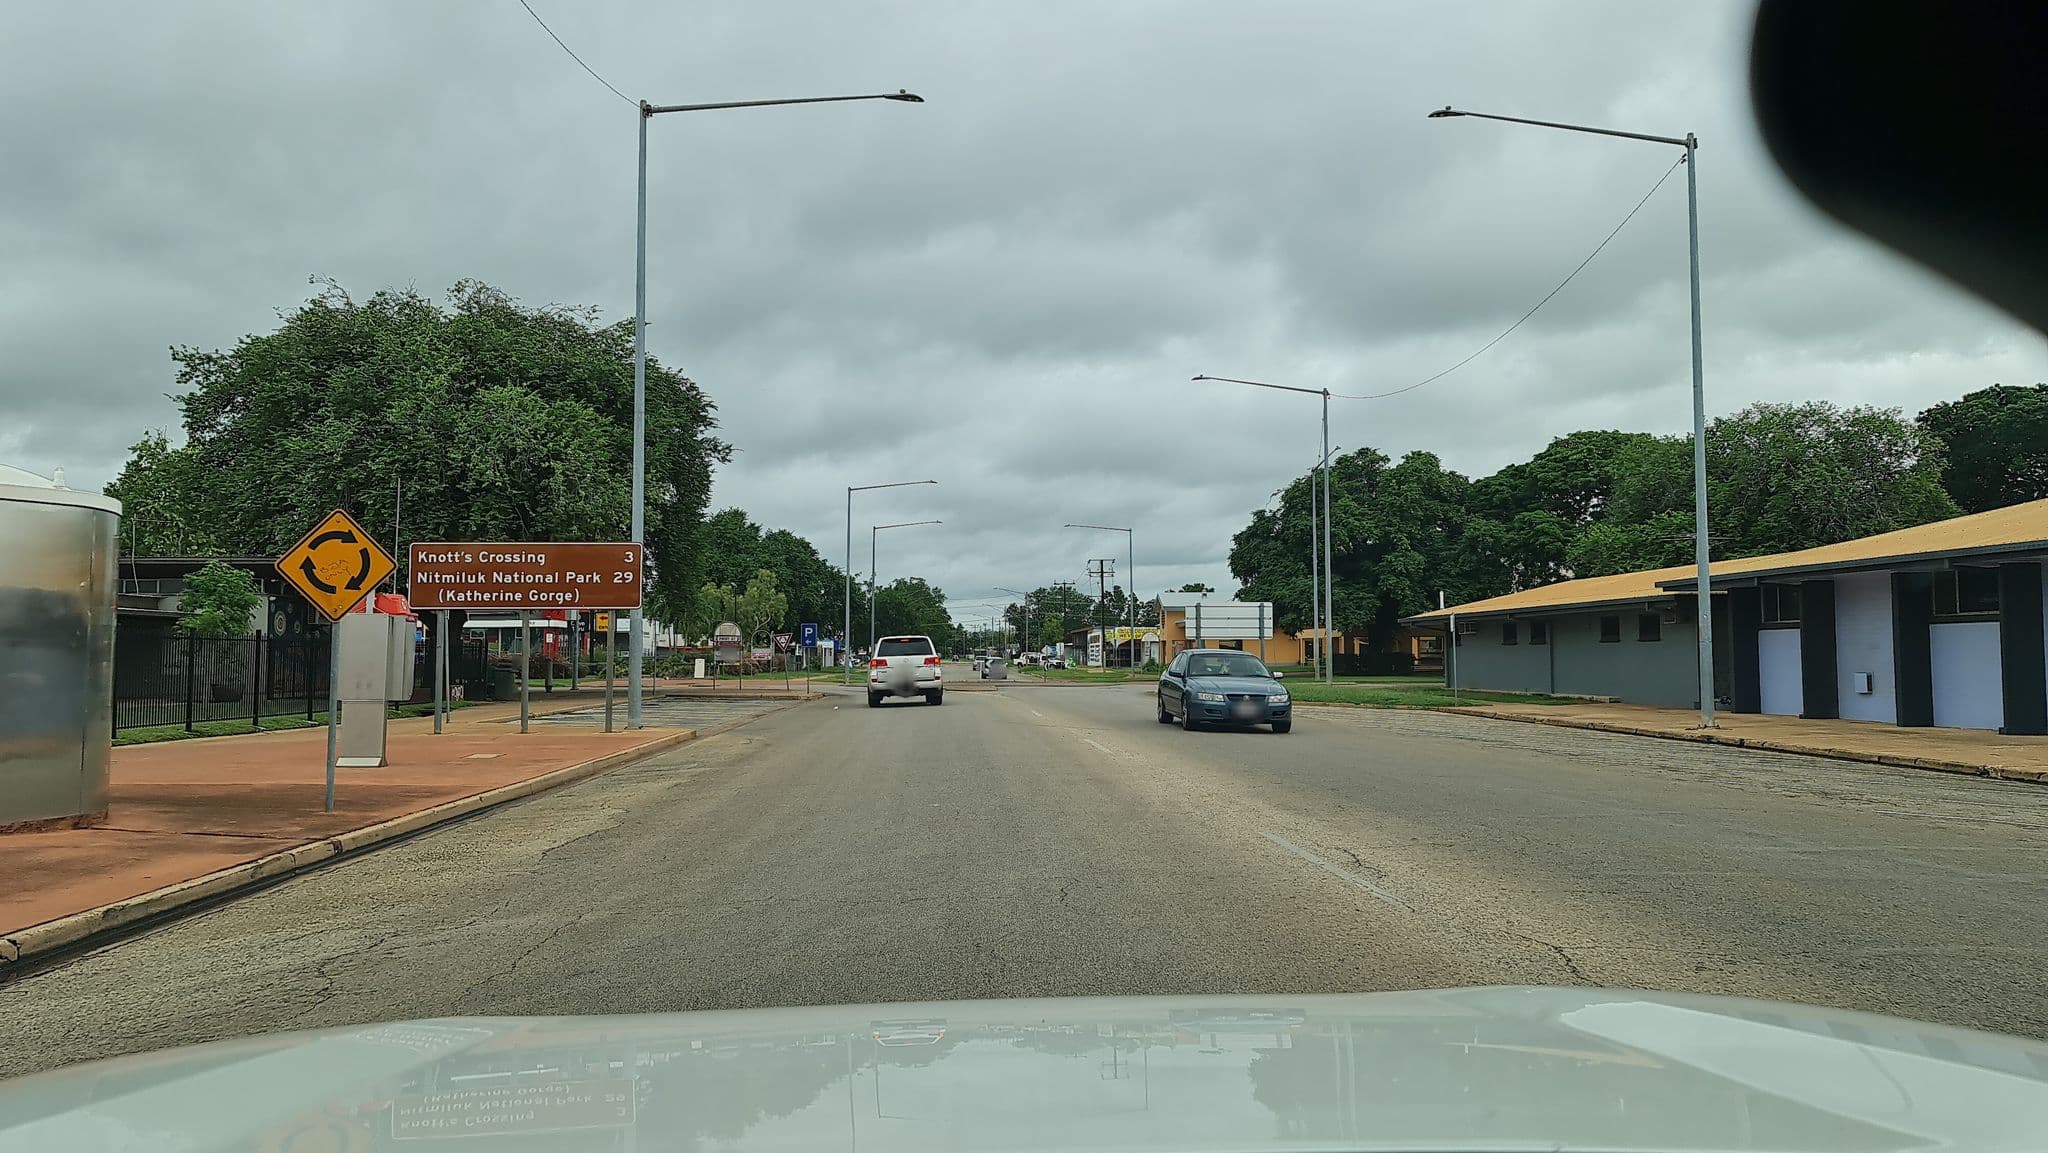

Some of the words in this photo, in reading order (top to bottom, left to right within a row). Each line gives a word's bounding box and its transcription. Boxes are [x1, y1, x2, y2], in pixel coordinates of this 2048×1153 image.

[418, 551, 473, 563] Knott's
[479, 551, 546, 566] Crossing
[624, 551, 634, 563] 3
[417, 571, 486, 584] Nitmiluk
[492, 571, 559, 584] National
[566, 571, 601, 584] Park
[613, 571, 634, 584] 29
[439, 588, 523, 604] (Katherine
[528, 587, 580, 605] Gorge)
[804, 627, 813, 638] P
